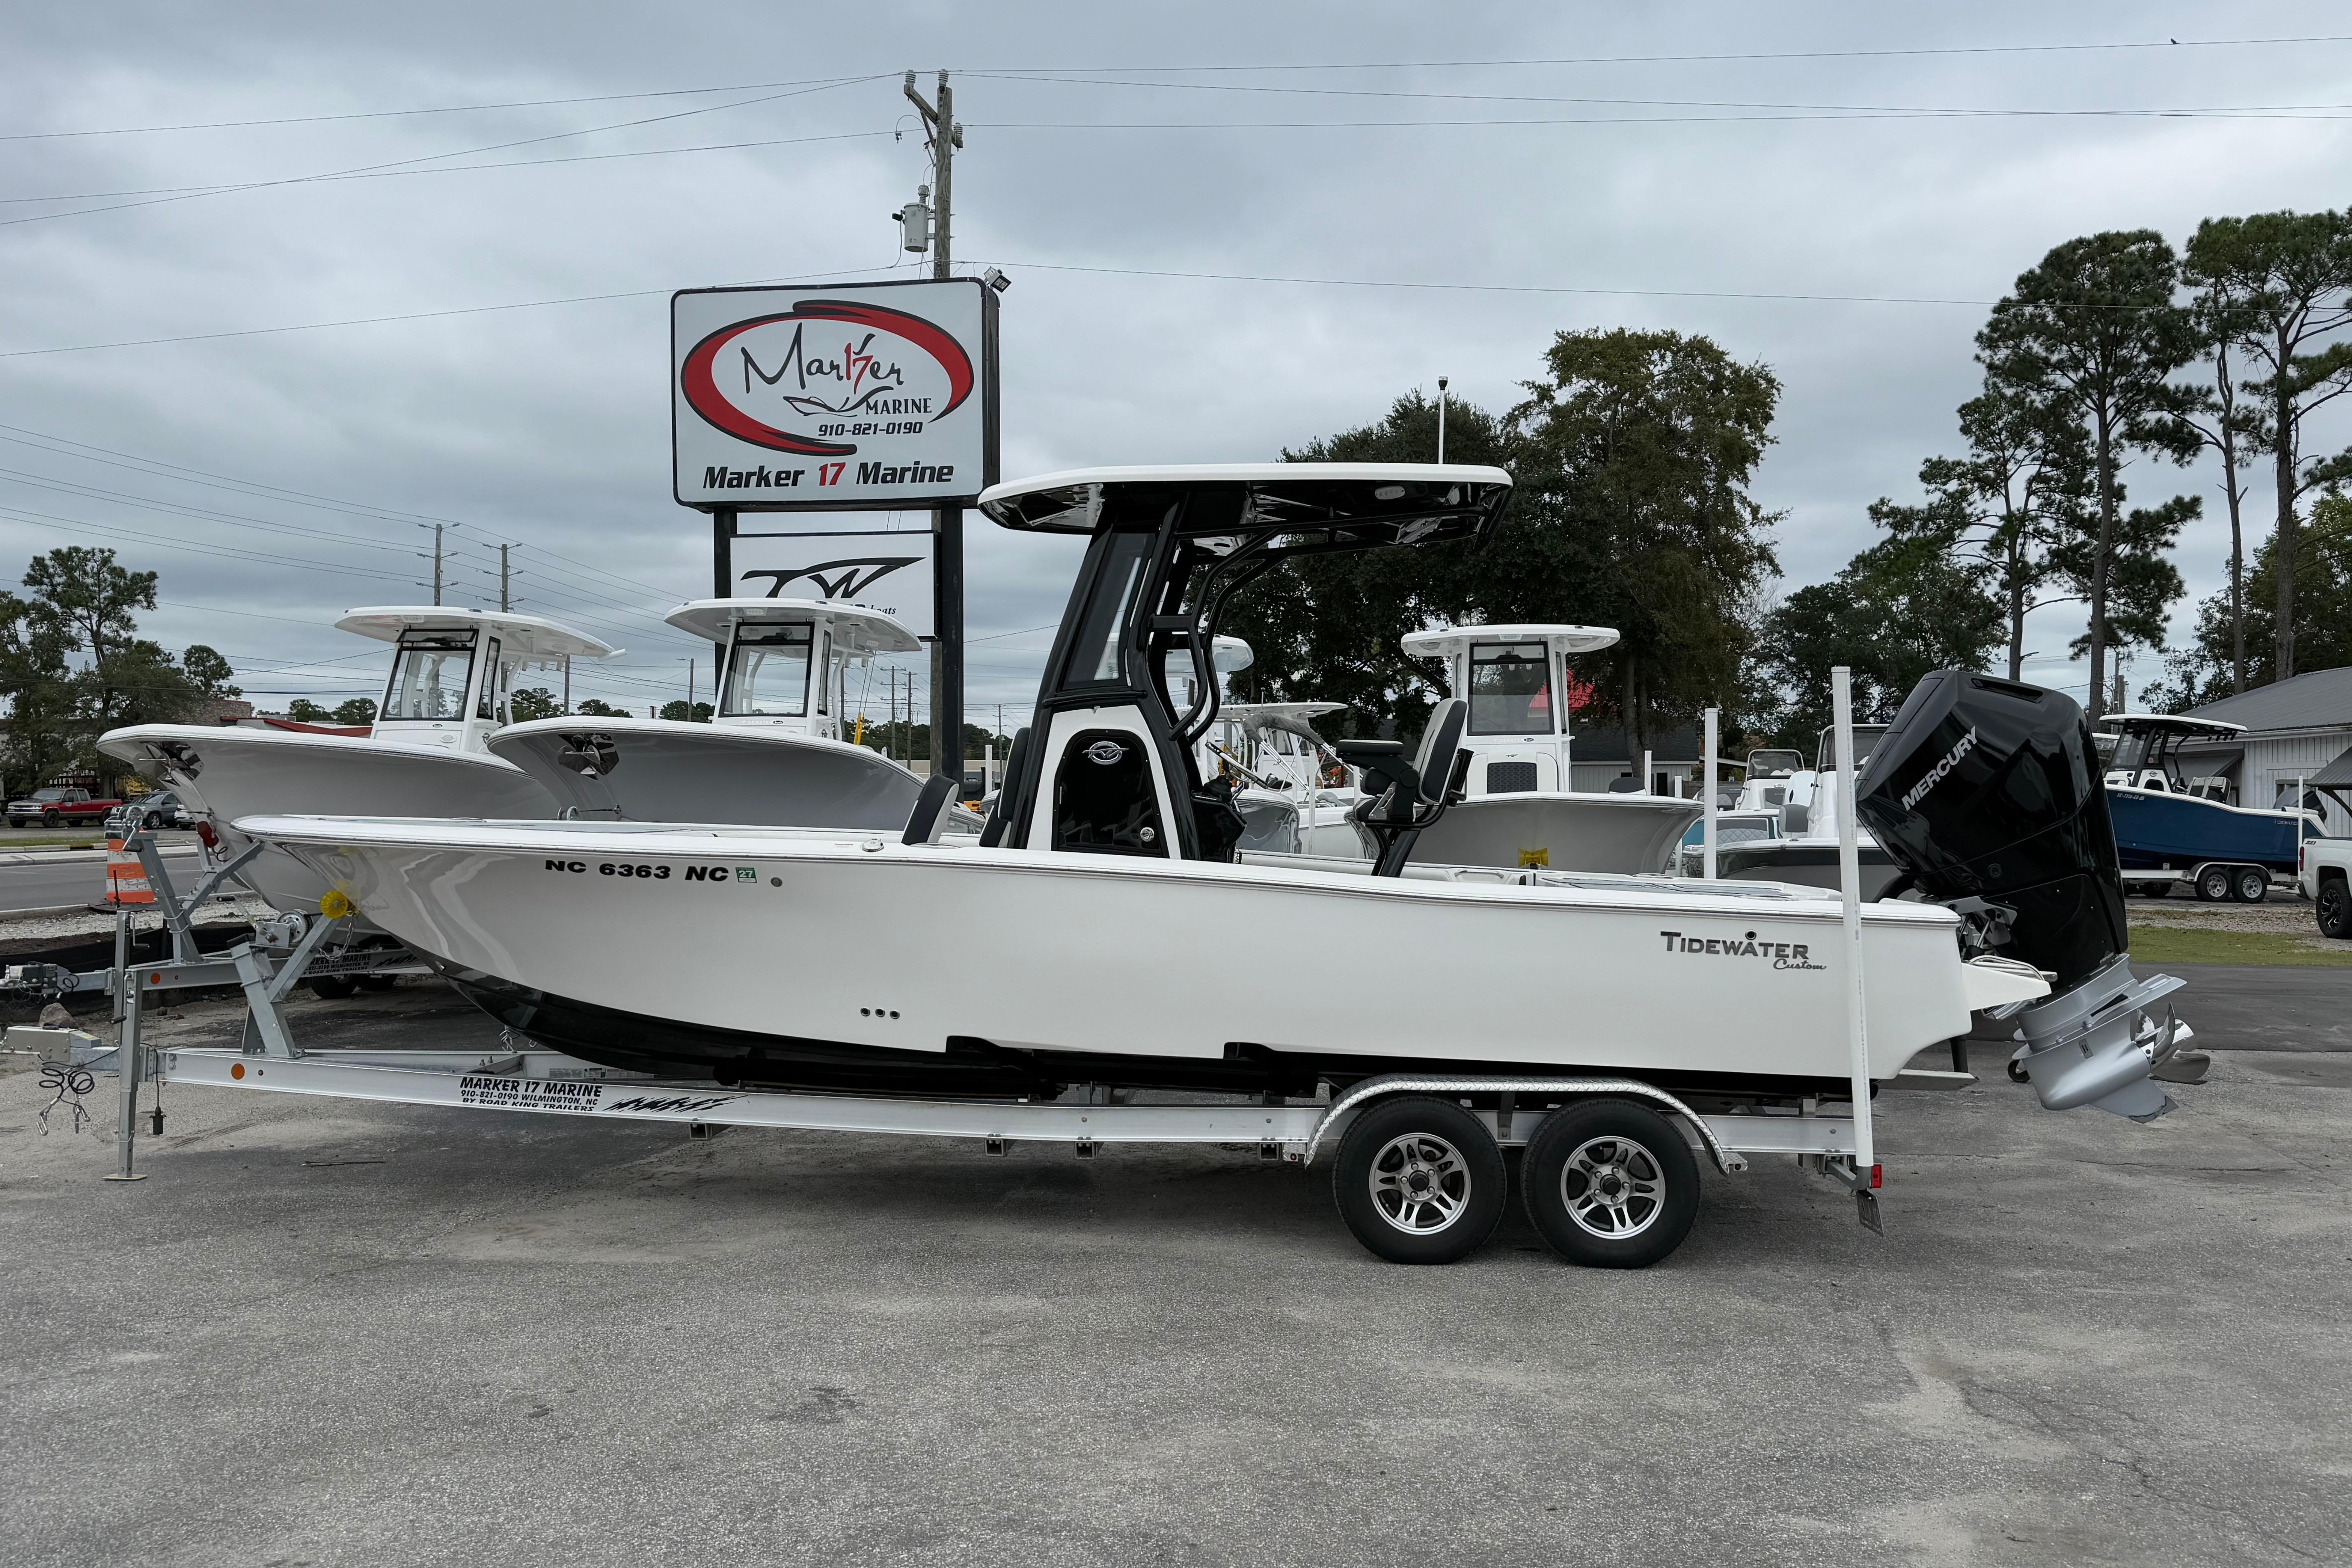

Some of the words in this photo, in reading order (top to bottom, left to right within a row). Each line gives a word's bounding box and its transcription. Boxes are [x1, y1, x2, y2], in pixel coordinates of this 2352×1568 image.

[866, 398, 932, 415] MARINE
[818, 422, 923, 436] 910-821-0190
[703, 465, 805, 489] Marker
[819, 462, 846, 486] 17
[856, 461, 954, 485] Marine
[1902, 726, 1977, 811] MERCURY
[545, 859, 586, 873] NC
[599, 863, 671, 879] 6363
[685, 866, 729, 882] NC
[1660, 931, 1809, 959] TIDEWATER
[343, 954, 371, 963] MARINE
[1773, 958, 1827, 970] Custom
[460, 1077, 520, 1093] MARKER
[525, 1081, 540, 1093] 17
[543, 1083, 603, 1097] MARINE
[461, 1090, 518, 1100] 910-821-0190
[522, 1094, 582, 1105] WILMINGTON,
[543, 1103, 595, 1111] TRAILERS
